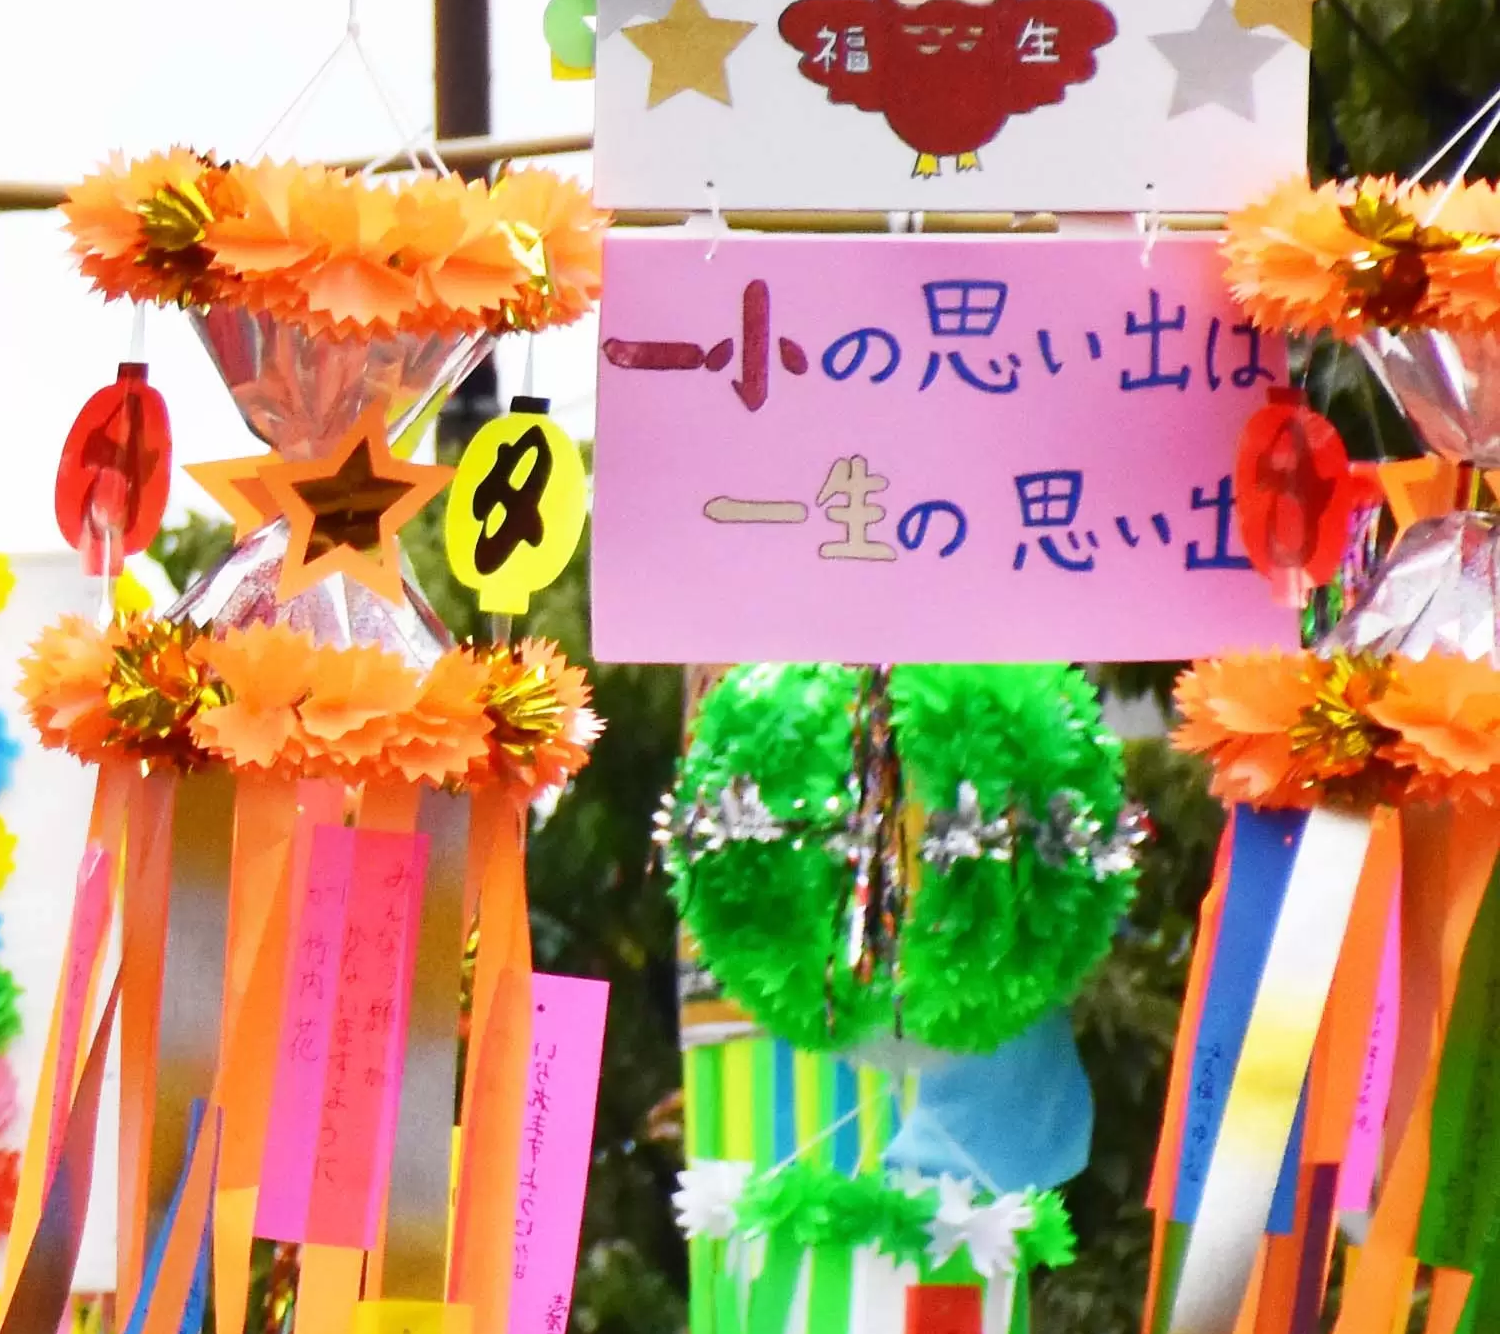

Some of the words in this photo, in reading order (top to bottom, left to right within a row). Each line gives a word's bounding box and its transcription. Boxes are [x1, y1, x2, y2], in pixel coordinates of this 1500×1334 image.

[813, 25, 871, 74] 福
[1017, 17, 1060, 67] 生
[603, 278, 1278, 412] 一小の思い出は
